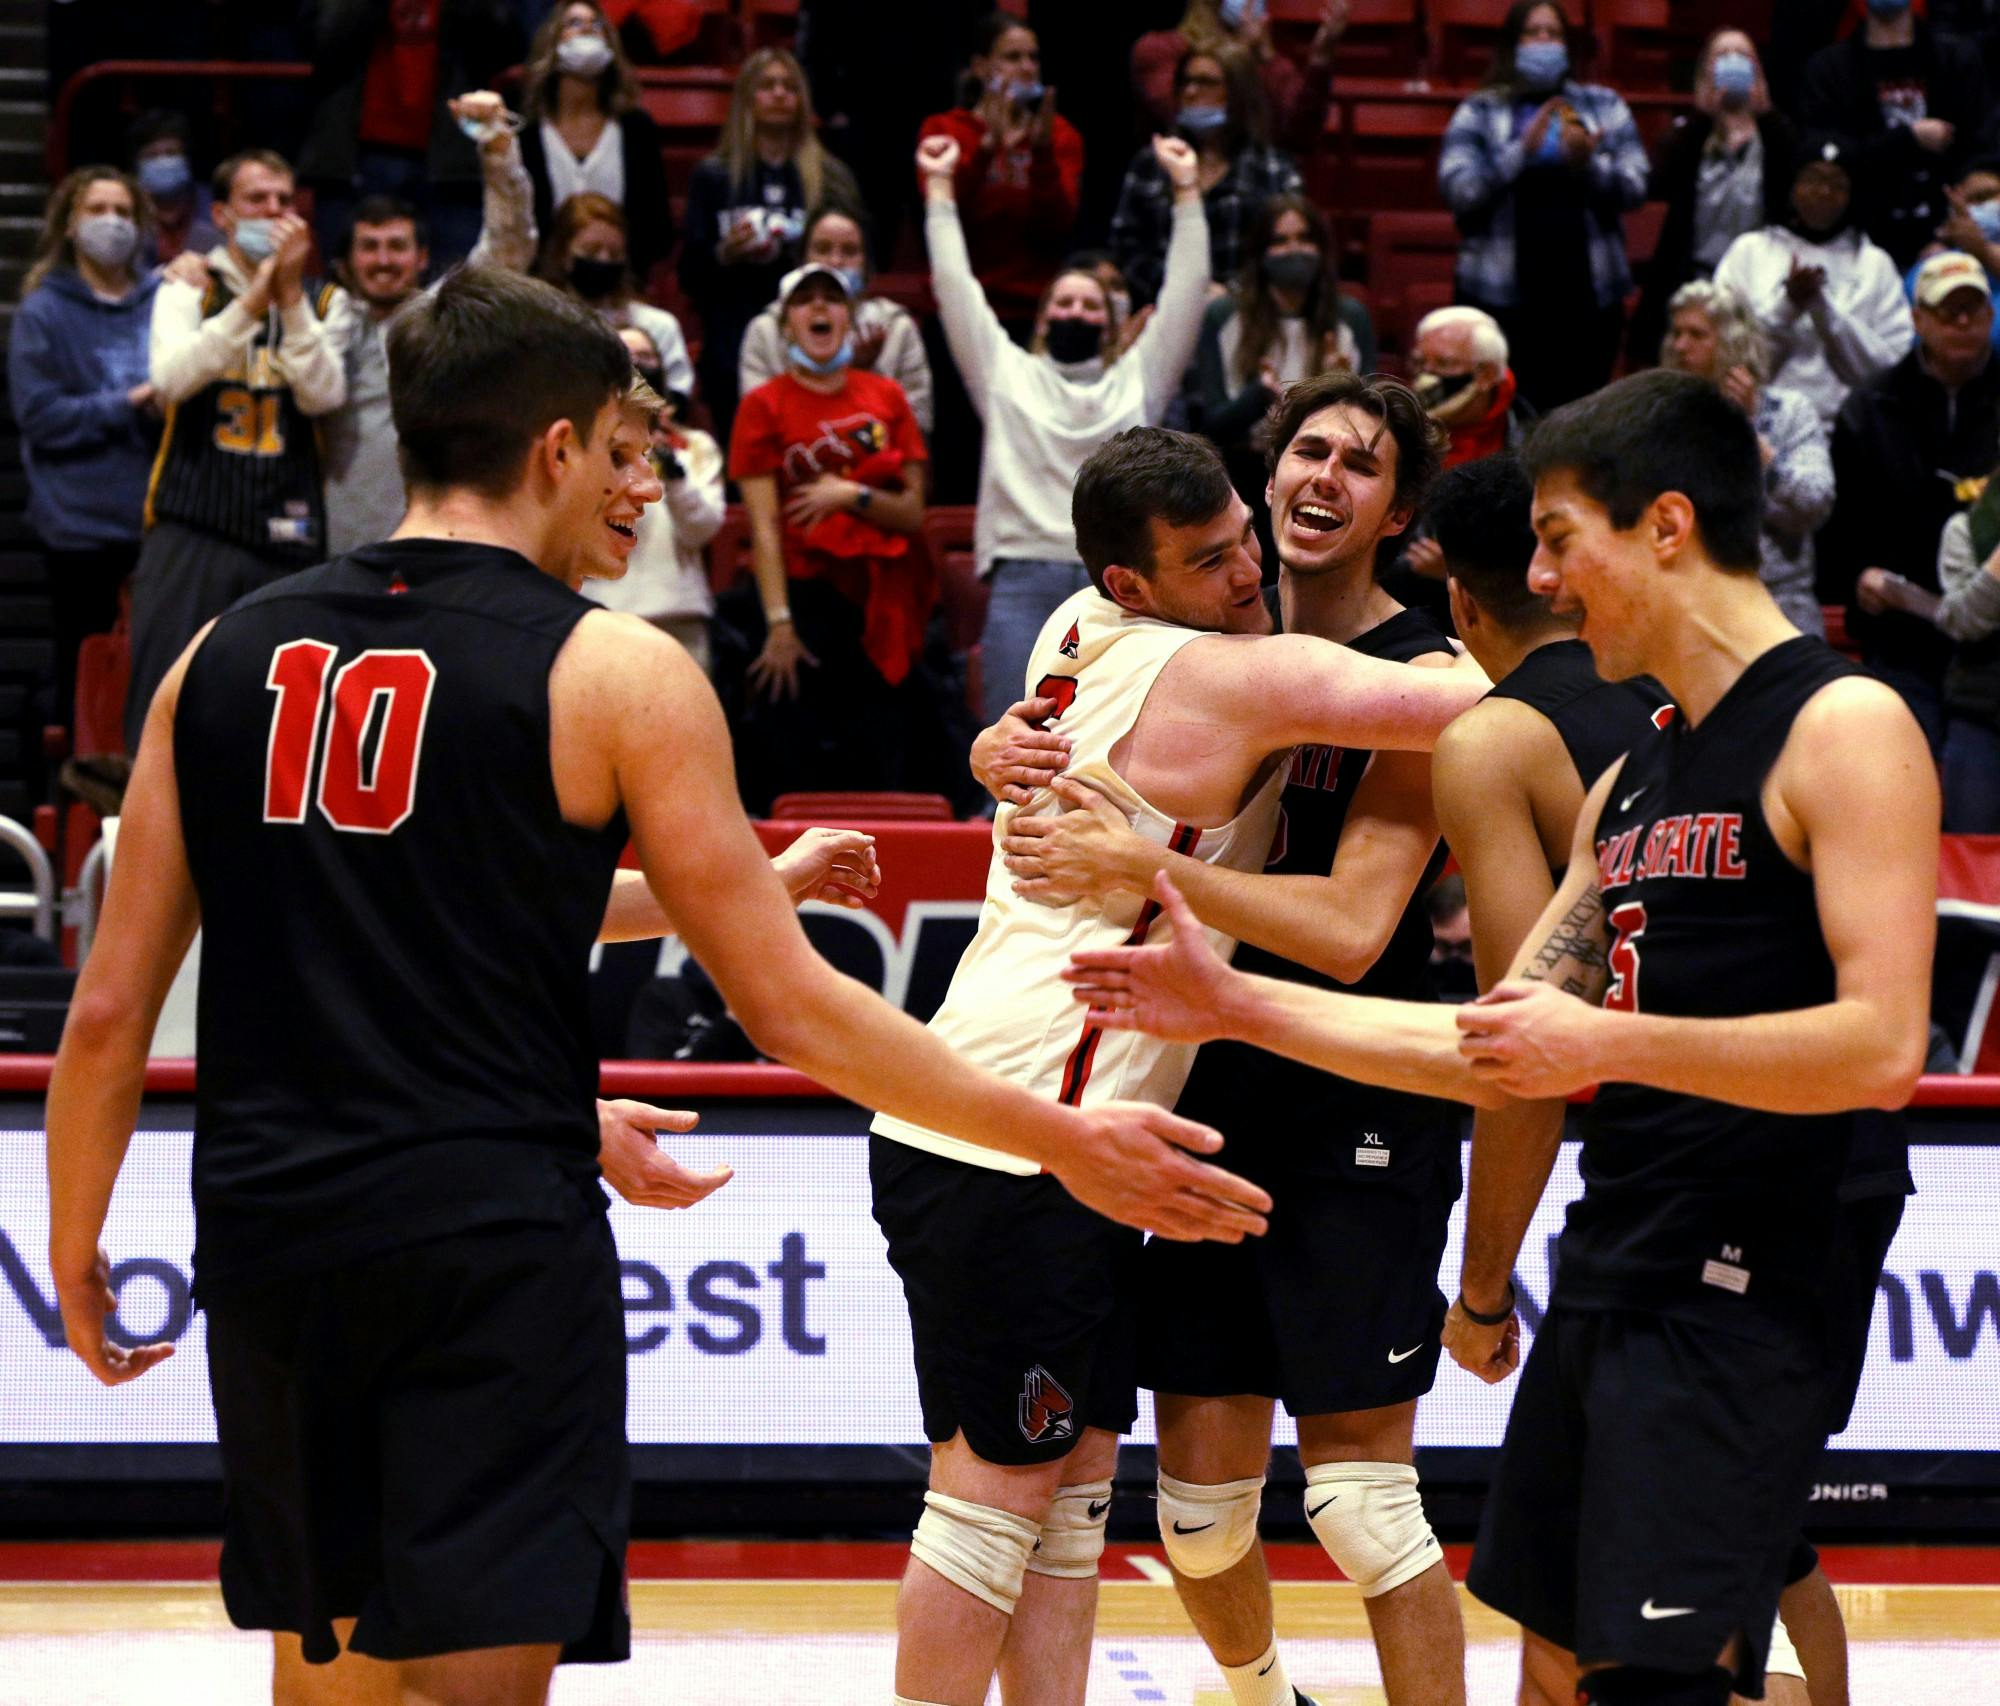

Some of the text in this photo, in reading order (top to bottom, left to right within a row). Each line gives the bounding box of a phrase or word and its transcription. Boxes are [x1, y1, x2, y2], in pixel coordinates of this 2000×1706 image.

[213, 389, 285, 457] 31
[262, 637, 438, 835] 10
[1636, 812, 1747, 882] STATE
[1363, 1132, 1384, 1145] XL
[1721, 1243, 1742, 1263] M
